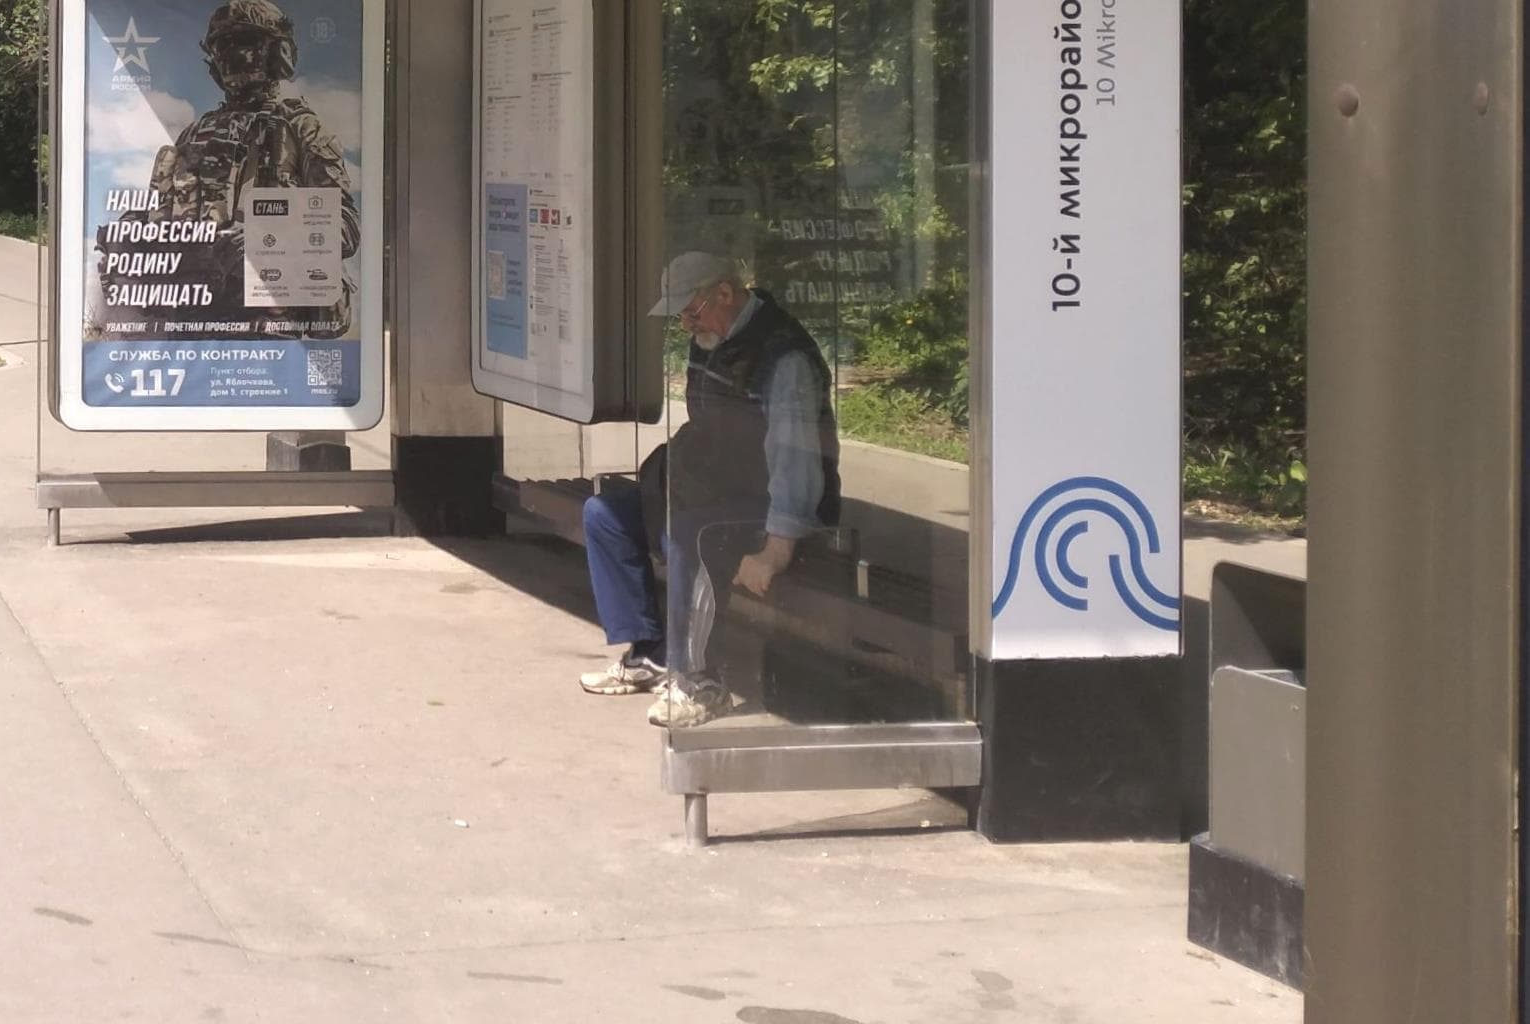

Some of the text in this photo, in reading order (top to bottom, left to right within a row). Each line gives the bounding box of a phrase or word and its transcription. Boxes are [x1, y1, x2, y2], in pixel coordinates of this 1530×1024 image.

[1096, 77, 1116, 106] 10
[106, 189, 160, 212] НАША
[106, 220, 218, 243] ПРОФЕССИЯ
[106, 252, 183, 277] РОДИНУ
[1051, 234, 1081, 312] 10-й
[106, 283, 213, 309] ЗАЩИЩАТЬ
[204, 321, 250, 333] ПРОФЕССИЯ
[108, 349, 286, 362] СЛУЖБА ПО КОНТРАКТУ
[130, 368, 186, 397] 117
[210, 389, 229, 397] дом
